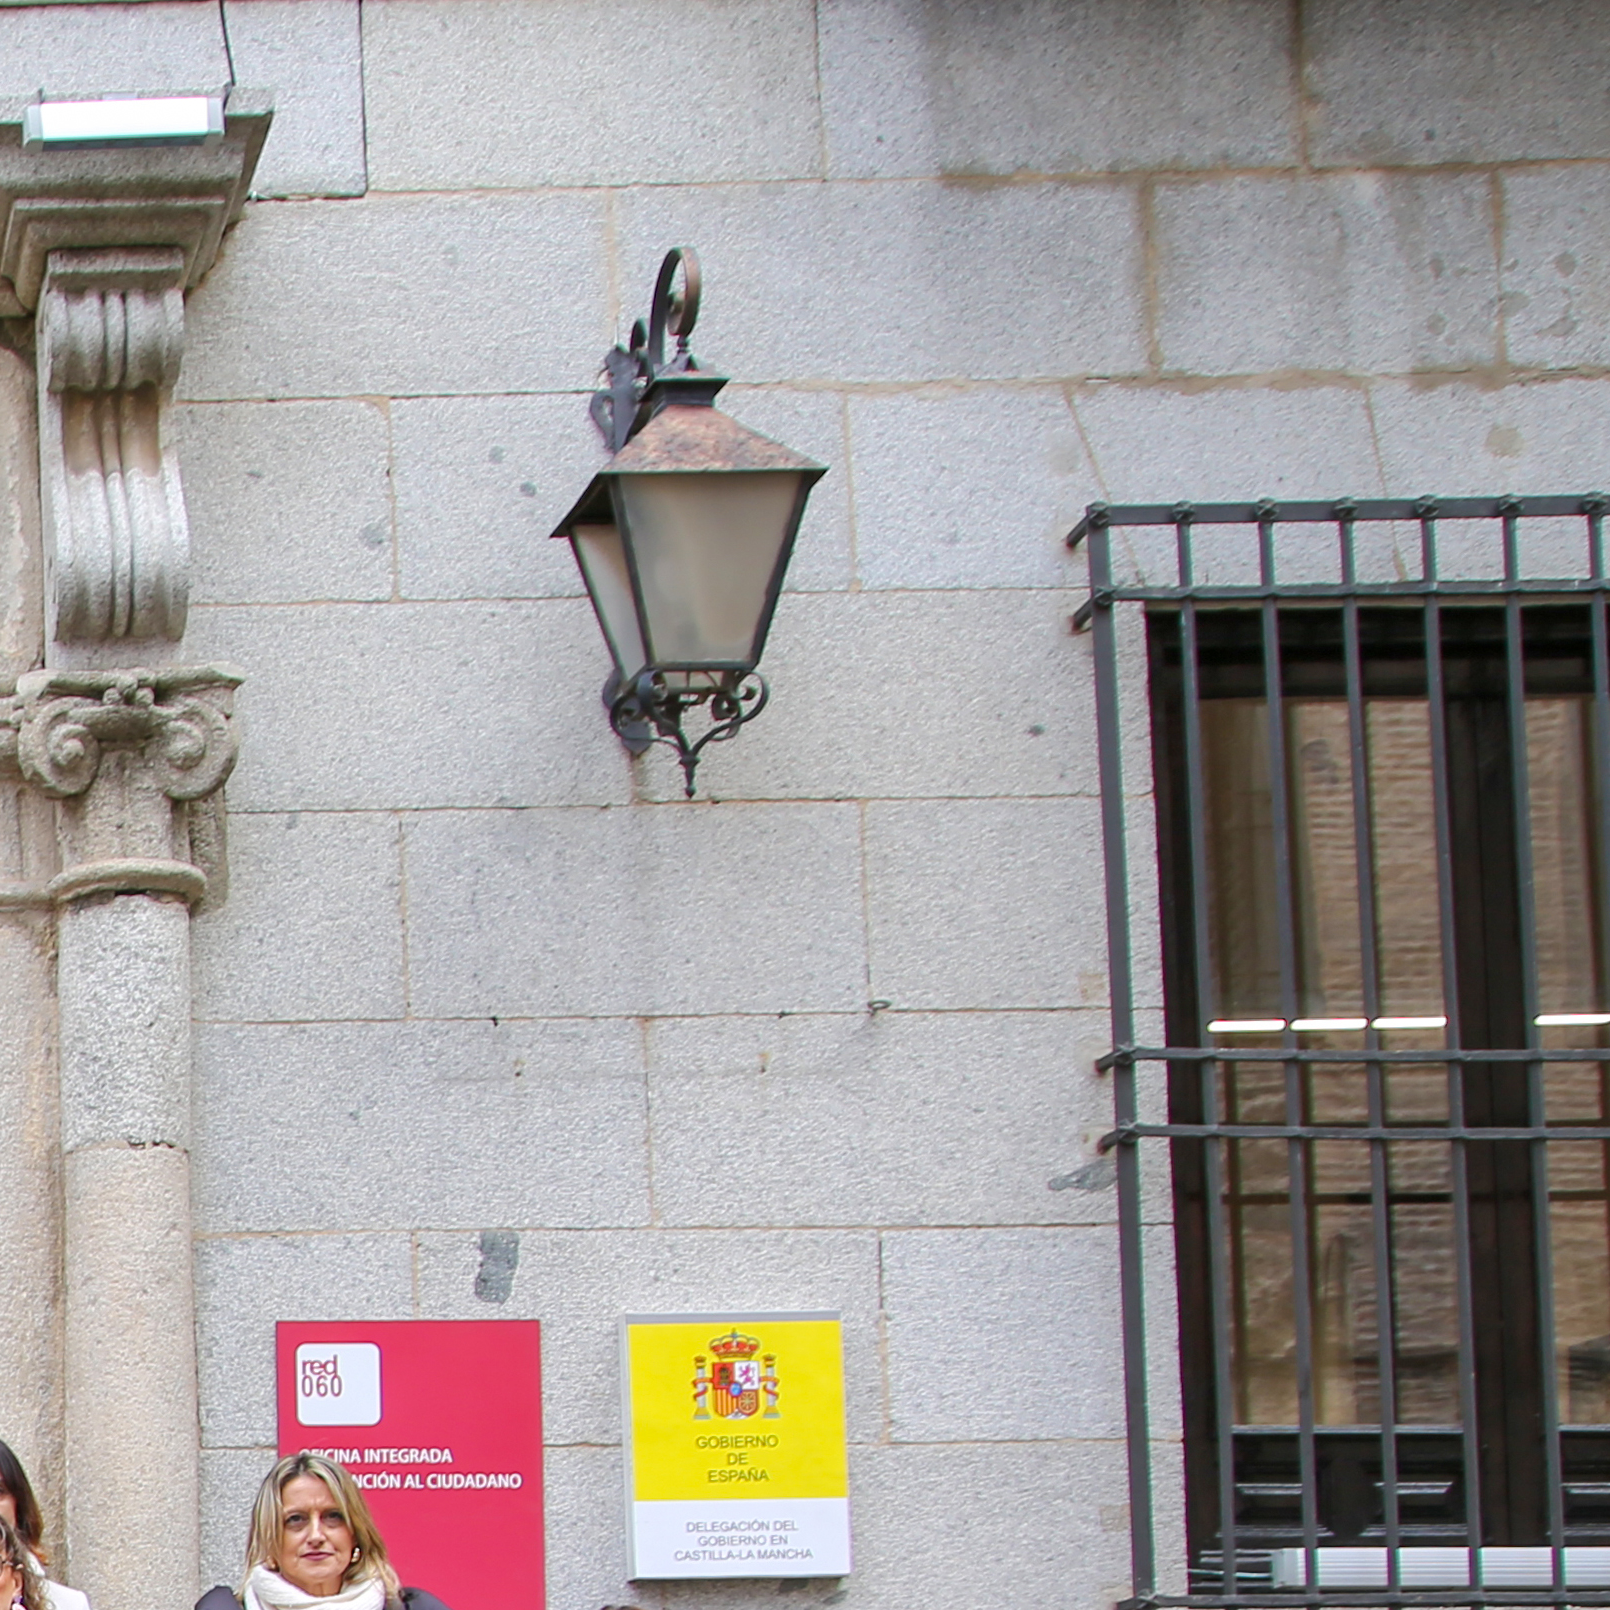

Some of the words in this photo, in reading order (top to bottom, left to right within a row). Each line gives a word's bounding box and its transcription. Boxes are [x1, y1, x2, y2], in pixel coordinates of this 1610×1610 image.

[301, 1354, 338, 1375] red
[301, 1375, 343, 1397] 060
[695, 1434, 779, 1449] GOBIERNO
[364, 1448, 453, 1464] INTEGRADA
[727, 1452, 749, 1466] DE
[351, 1470, 401, 1489] NCIÓN
[404, 1473, 424, 1489] AL
[426, 1473, 523, 1489] CIUDADANO
[707, 1466, 770, 1483] ESPAÑA
[686, 1519, 770, 1533] DELEGACIÓN
[773, 1520, 799, 1532] DEL
[698, 1535, 767, 1547] GOBIERNO
[770, 1535, 788, 1545] EN
[674, 1550, 755, 1561] CASTILLA-LA
[757, 1549, 813, 1560] MANCHA
